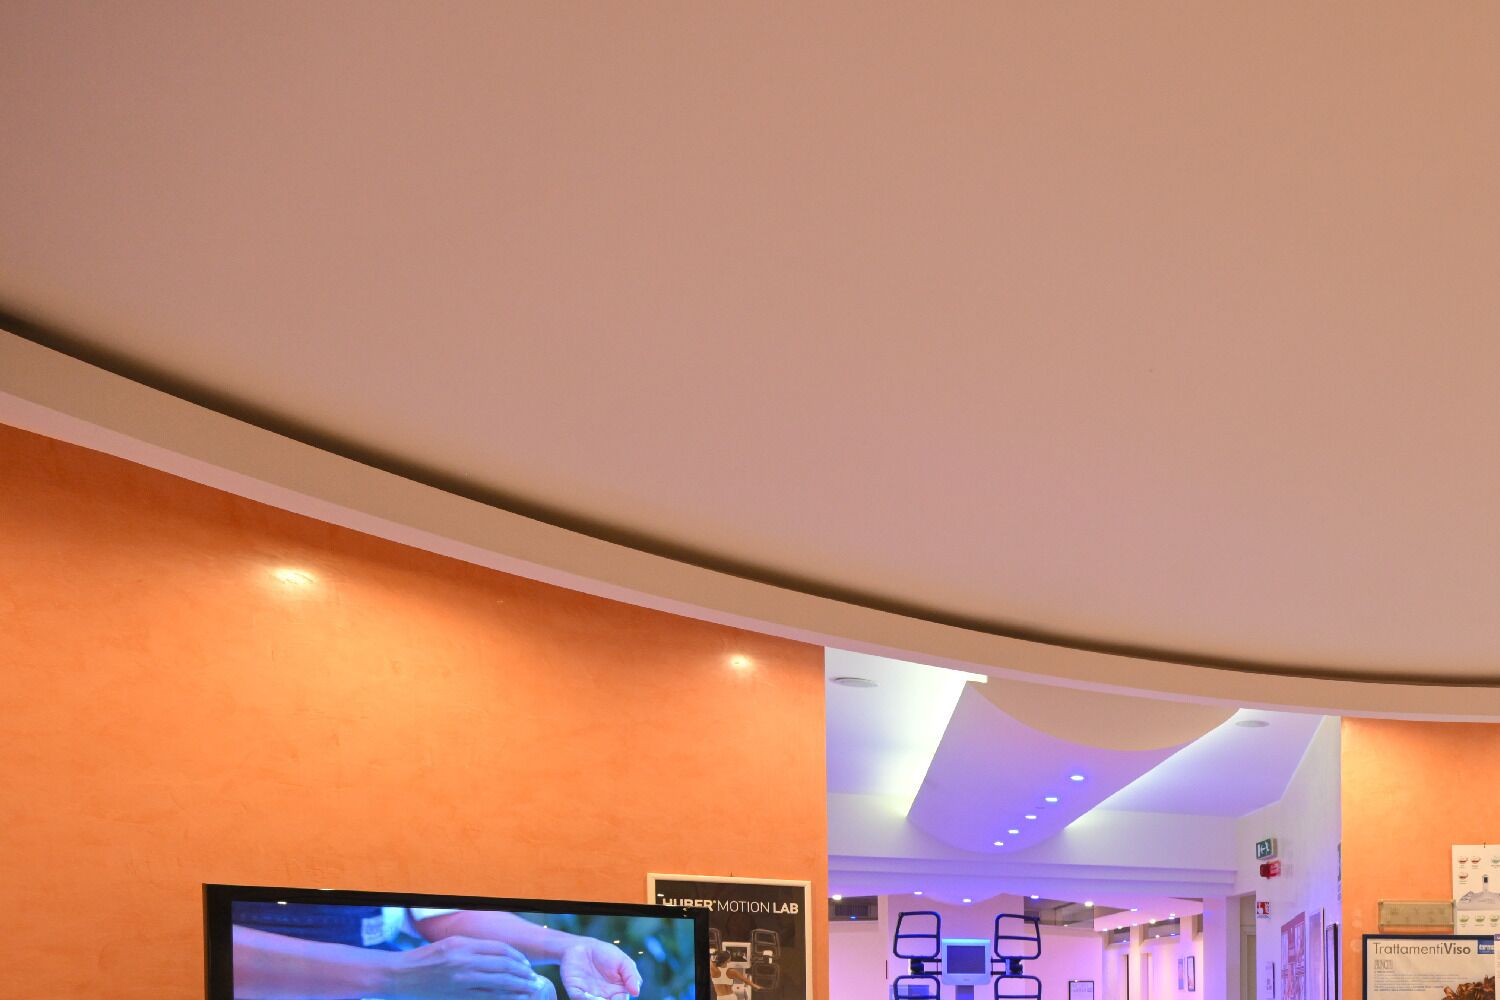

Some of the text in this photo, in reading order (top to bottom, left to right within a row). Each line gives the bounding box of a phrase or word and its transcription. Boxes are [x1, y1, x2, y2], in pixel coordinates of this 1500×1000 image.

[717, 900, 770, 913] MOTION
[773, 902, 799, 914] LAB
[1373, 942, 1471, 955] TrattamentiViso
